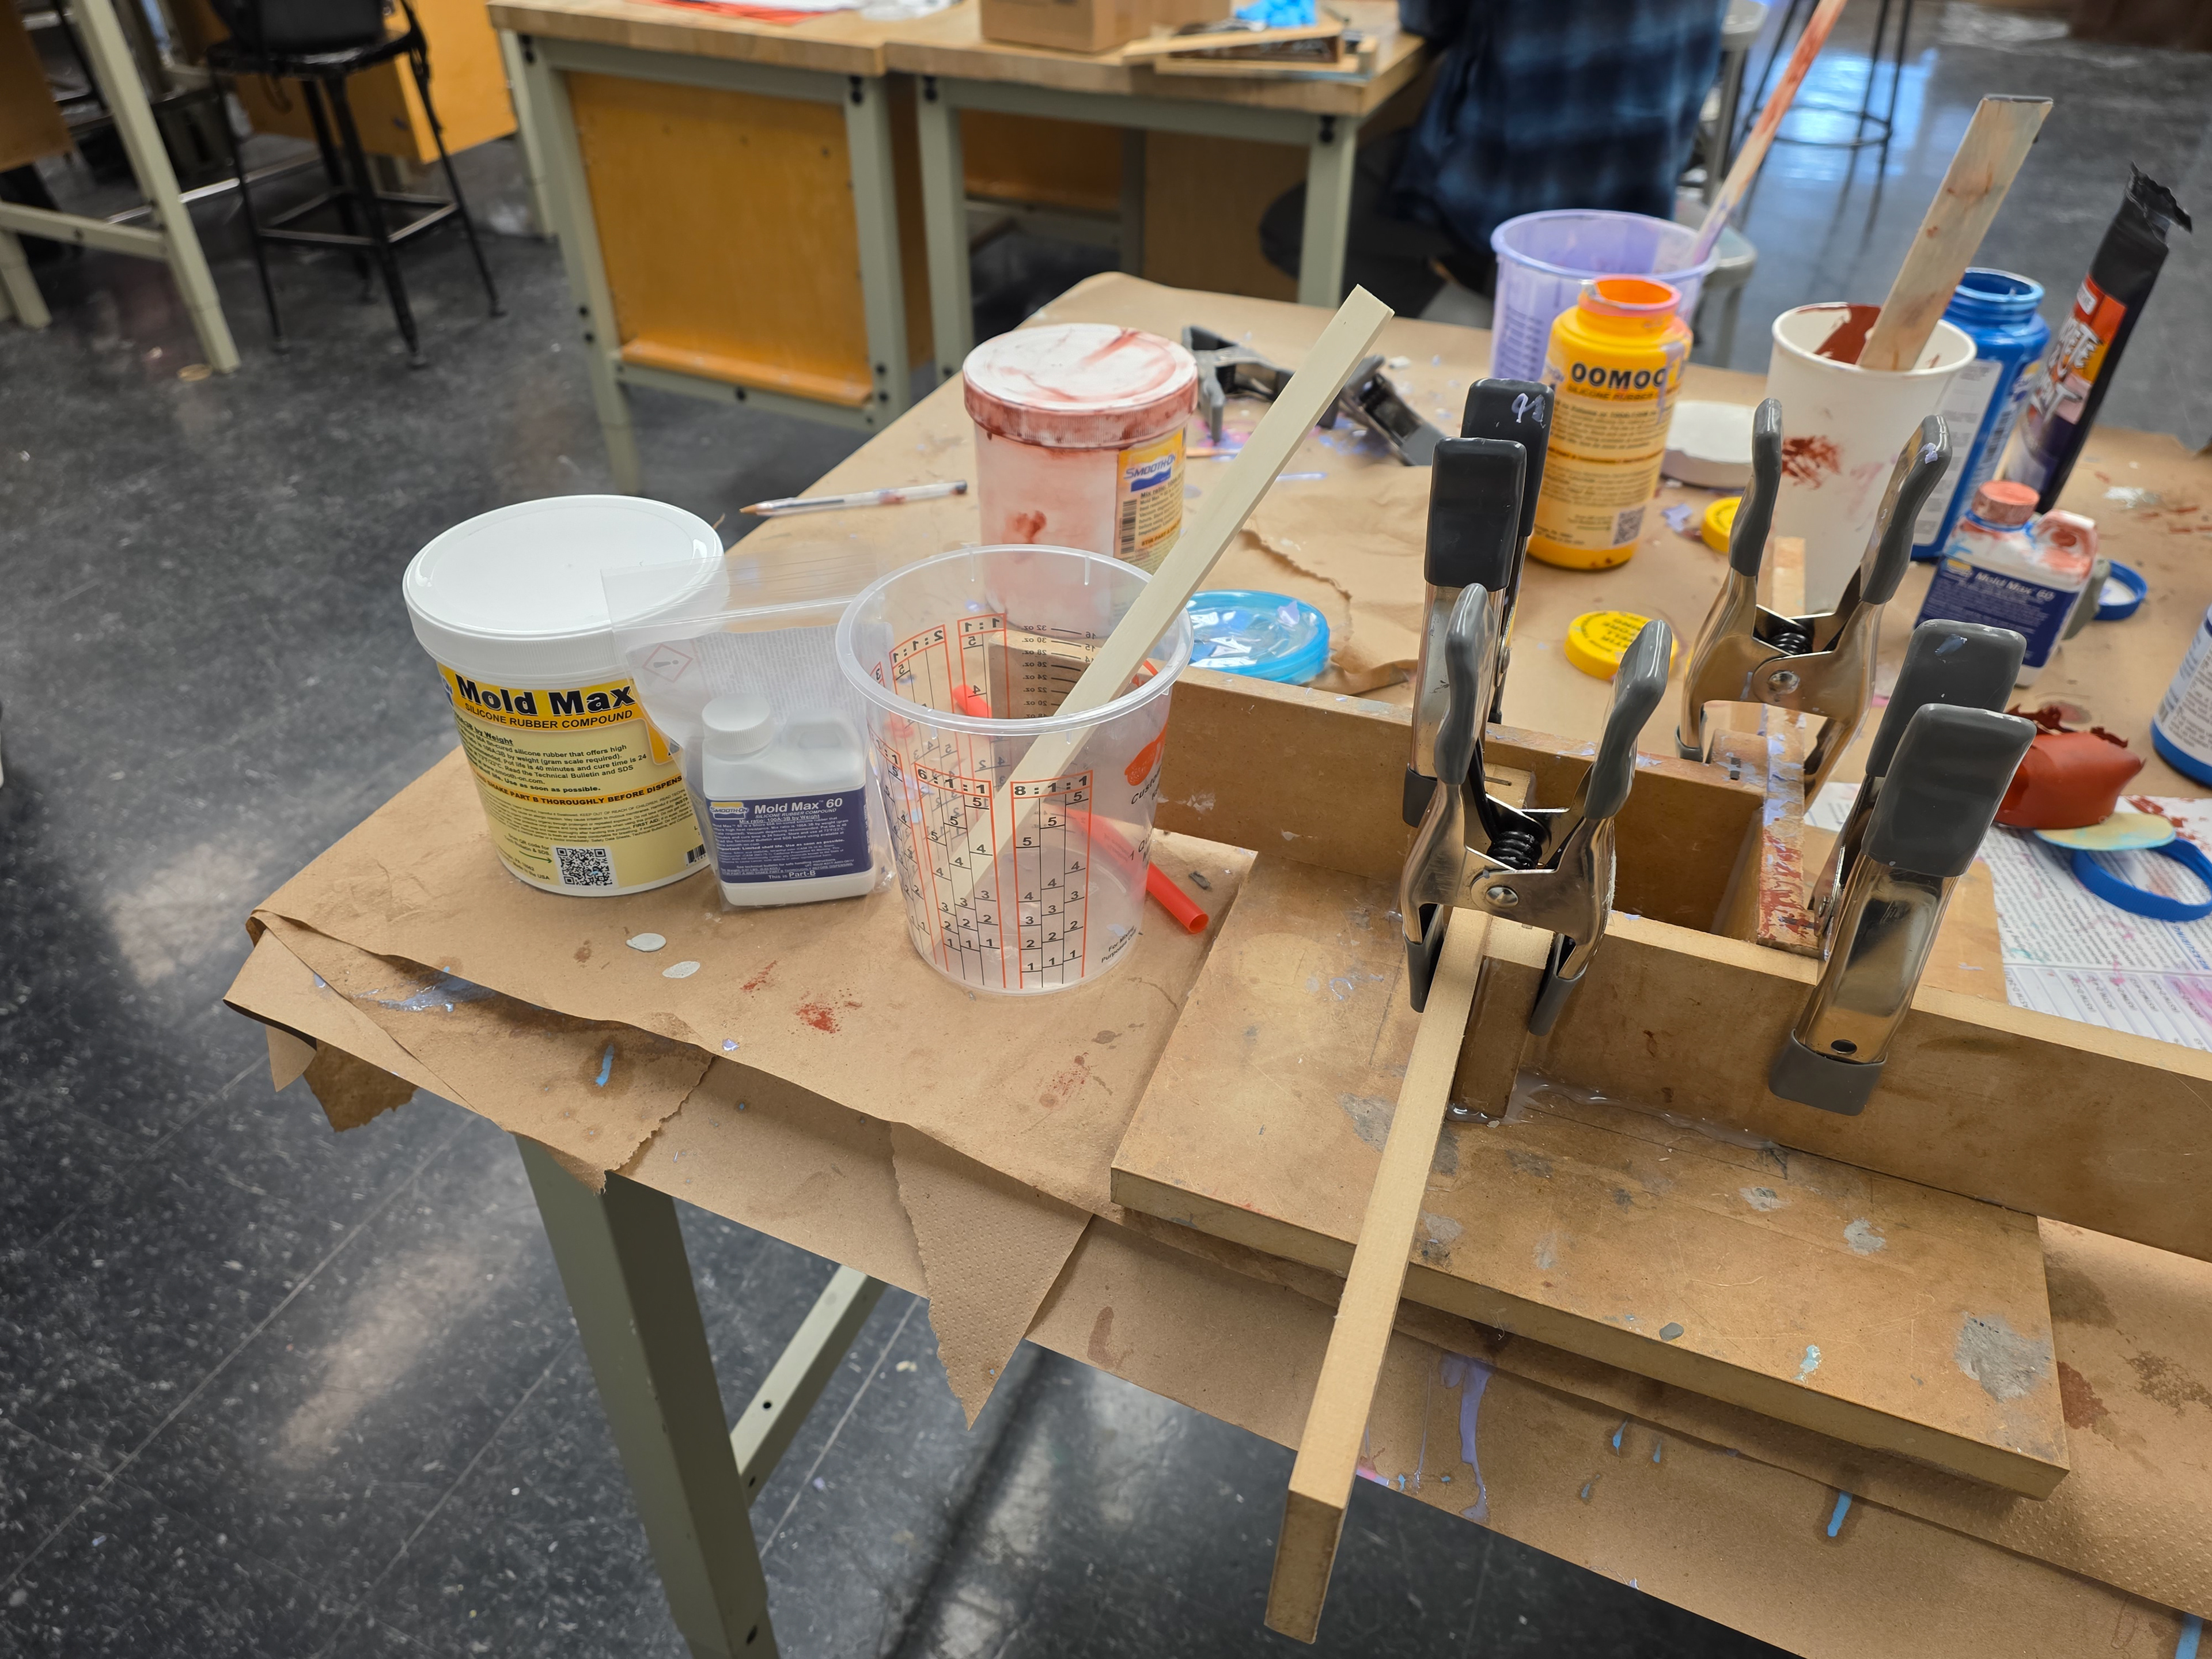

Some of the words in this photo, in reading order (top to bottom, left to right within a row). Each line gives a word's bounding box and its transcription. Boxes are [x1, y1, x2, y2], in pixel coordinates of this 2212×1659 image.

[1124, 454, 1176, 479] SMOOTH-ON
[455, 673, 538, 716] Mold
[548, 686, 635, 717] Max
[465, 703, 506, 724] SILICONE
[510, 718, 558, 729] RUBBER
[562, 710, 632, 728] COMPOUND
[484, 731, 514, 746] Weight
[610, 745, 627, 753] high
[516, 756, 539, 764] weight
[586, 753, 622, 763] required).
[505, 766, 520, 774] Read
[618, 765, 634, 773] SDS
[504, 778, 517, 786] Use
[510, 790, 531, 801] PART
[540, 797, 605, 805] THOROUGHLY
[608, 790, 645, 802] BEFORE
[647, 775, 683, 793] DISPENS
[1073, 791, 1082, 801] 5
[755, 803, 787, 814] Mold
[826, 798, 843, 808] 60
[972, 797, 982, 806] 5
[950, 816, 959, 825] 5
[1048, 817, 1057, 826] 5
[931, 831, 939, 841] 5
[1022, 837, 1032, 846] 5
[976, 844, 986, 853] 4
[955, 857, 964, 866] 4
[1071, 861, 1080, 870] 4
[936, 868, 944, 876] 4
[1047, 878, 1056, 887] 4
[981, 890, 990, 899] 3
[1024, 892, 1033, 900] 4
[1071, 891, 1079, 900] 3
[941, 902, 949, 911] 3
[960, 897, 968, 907] 3
[1048, 905, 1056, 914] 3
[962, 918, 971, 927] 2
[983, 915, 992, 923] 2
[1025, 916, 1034, 925] 3
[944, 921, 952, 930] 2
[1070, 921, 1078, 930] 2
[1048, 932, 1056, 941] 2
[947, 938, 953, 946] 1
[965, 940, 972, 948] 1
[986, 938, 993, 946] 1
[1026, 940, 1035, 948] 2
[1108, 942, 1119, 952] For
[1070, 950, 1075, 958] 1
